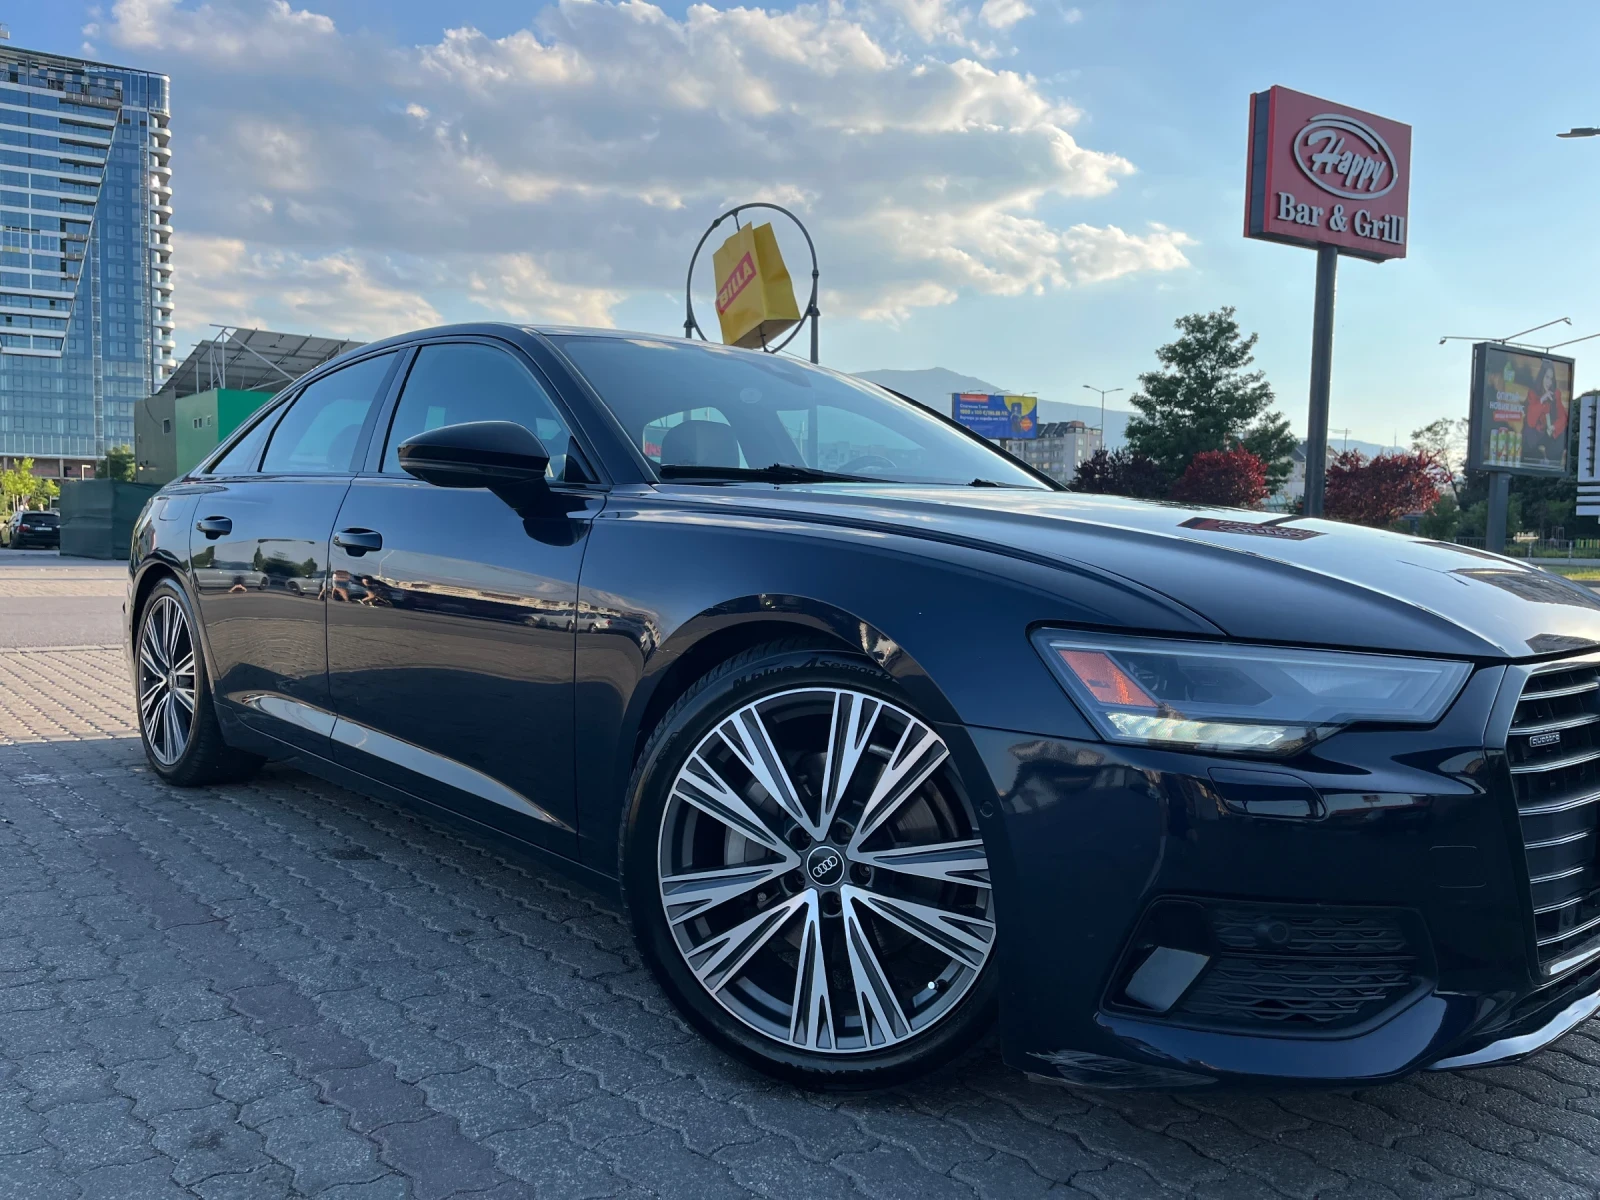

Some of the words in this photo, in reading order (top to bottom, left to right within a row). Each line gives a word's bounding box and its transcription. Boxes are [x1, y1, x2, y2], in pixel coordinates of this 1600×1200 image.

[1307, 129, 1387, 192] Happy
[1277, 192, 1324, 227] Bar
[1329, 204, 1348, 232] &
[1354, 209, 1405, 245] Grill
[718, 261, 753, 307] BILLA
[1532, 734, 1560, 745] quattro
